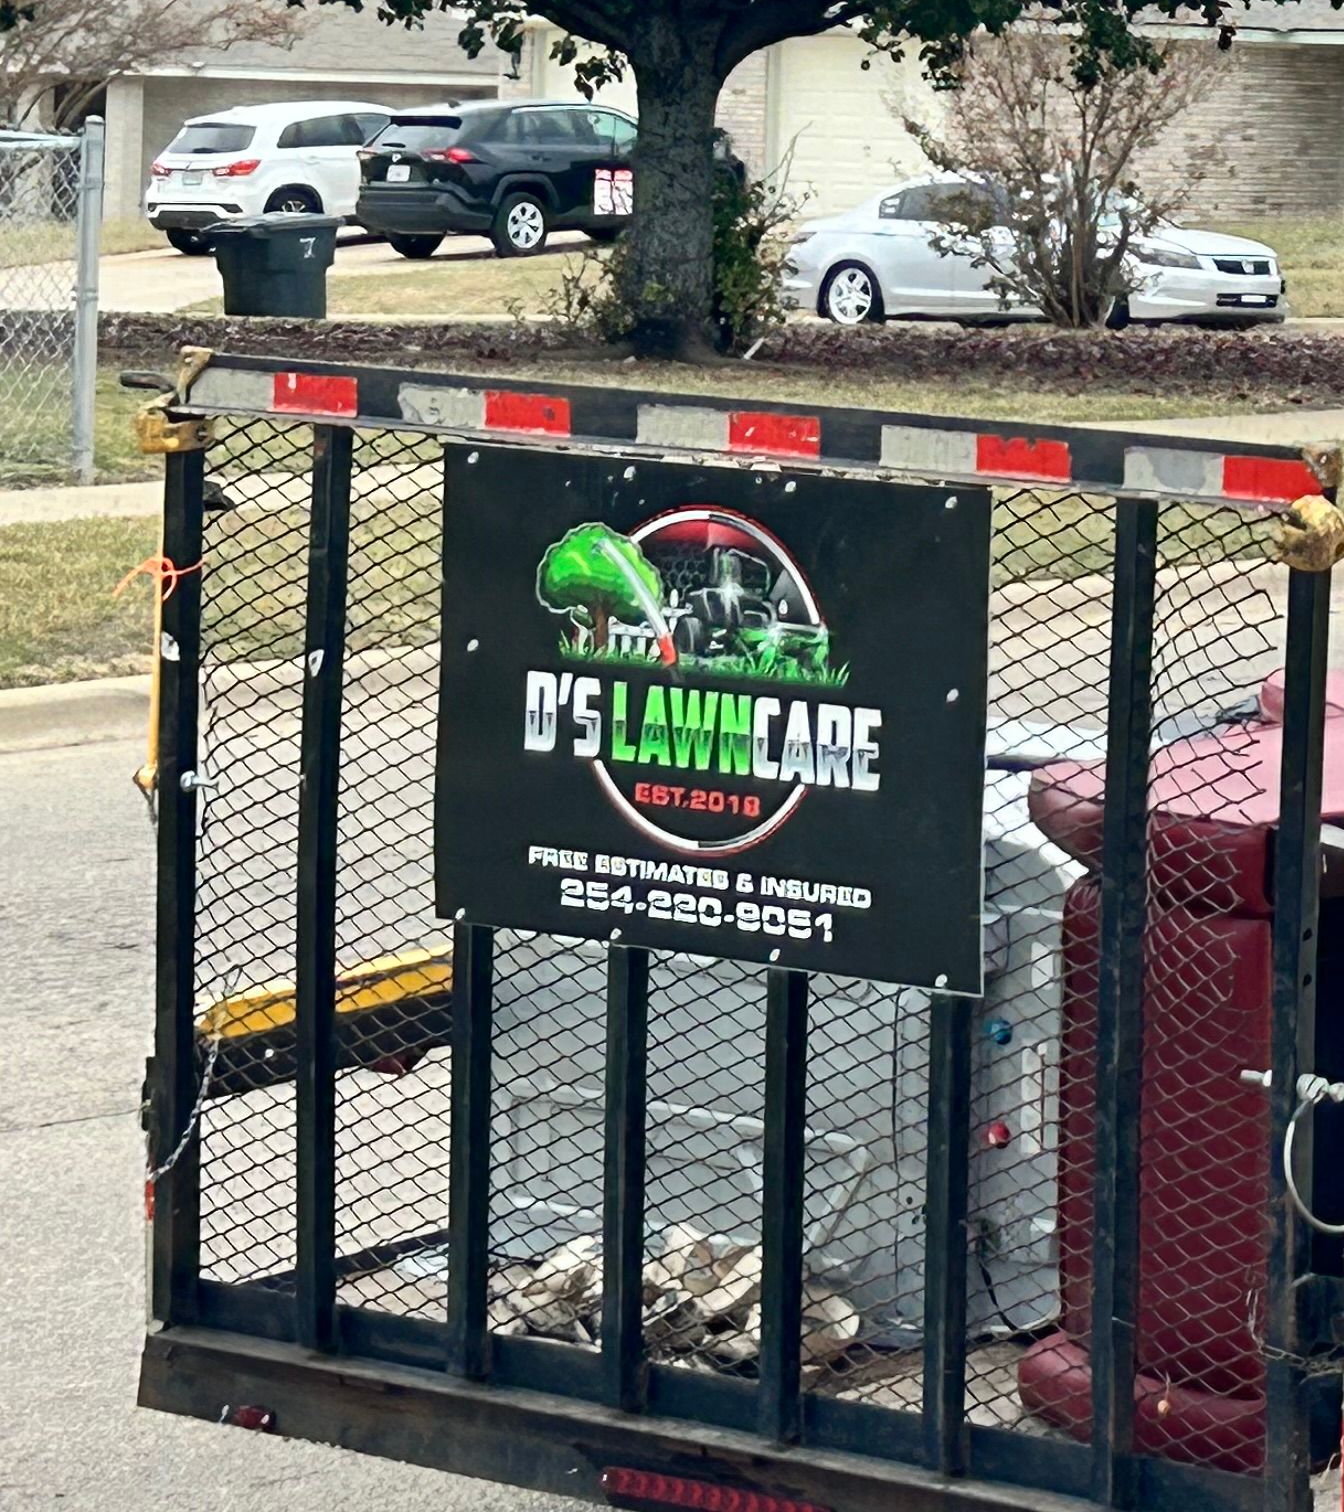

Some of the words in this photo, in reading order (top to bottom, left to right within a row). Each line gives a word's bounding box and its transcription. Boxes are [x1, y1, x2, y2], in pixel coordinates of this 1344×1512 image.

[523, 669, 602, 759] D'S
[610, 680, 884, 793] LAWNCARE
[634, 782, 762, 818] EST.2018
[527, 845, 589, 871] FREE
[594, 853, 730, 890] ESTIMATES
[735, 873, 755, 893] &
[760, 875, 873, 909] INSURED
[559, 877, 834, 943] 254-220-9051
